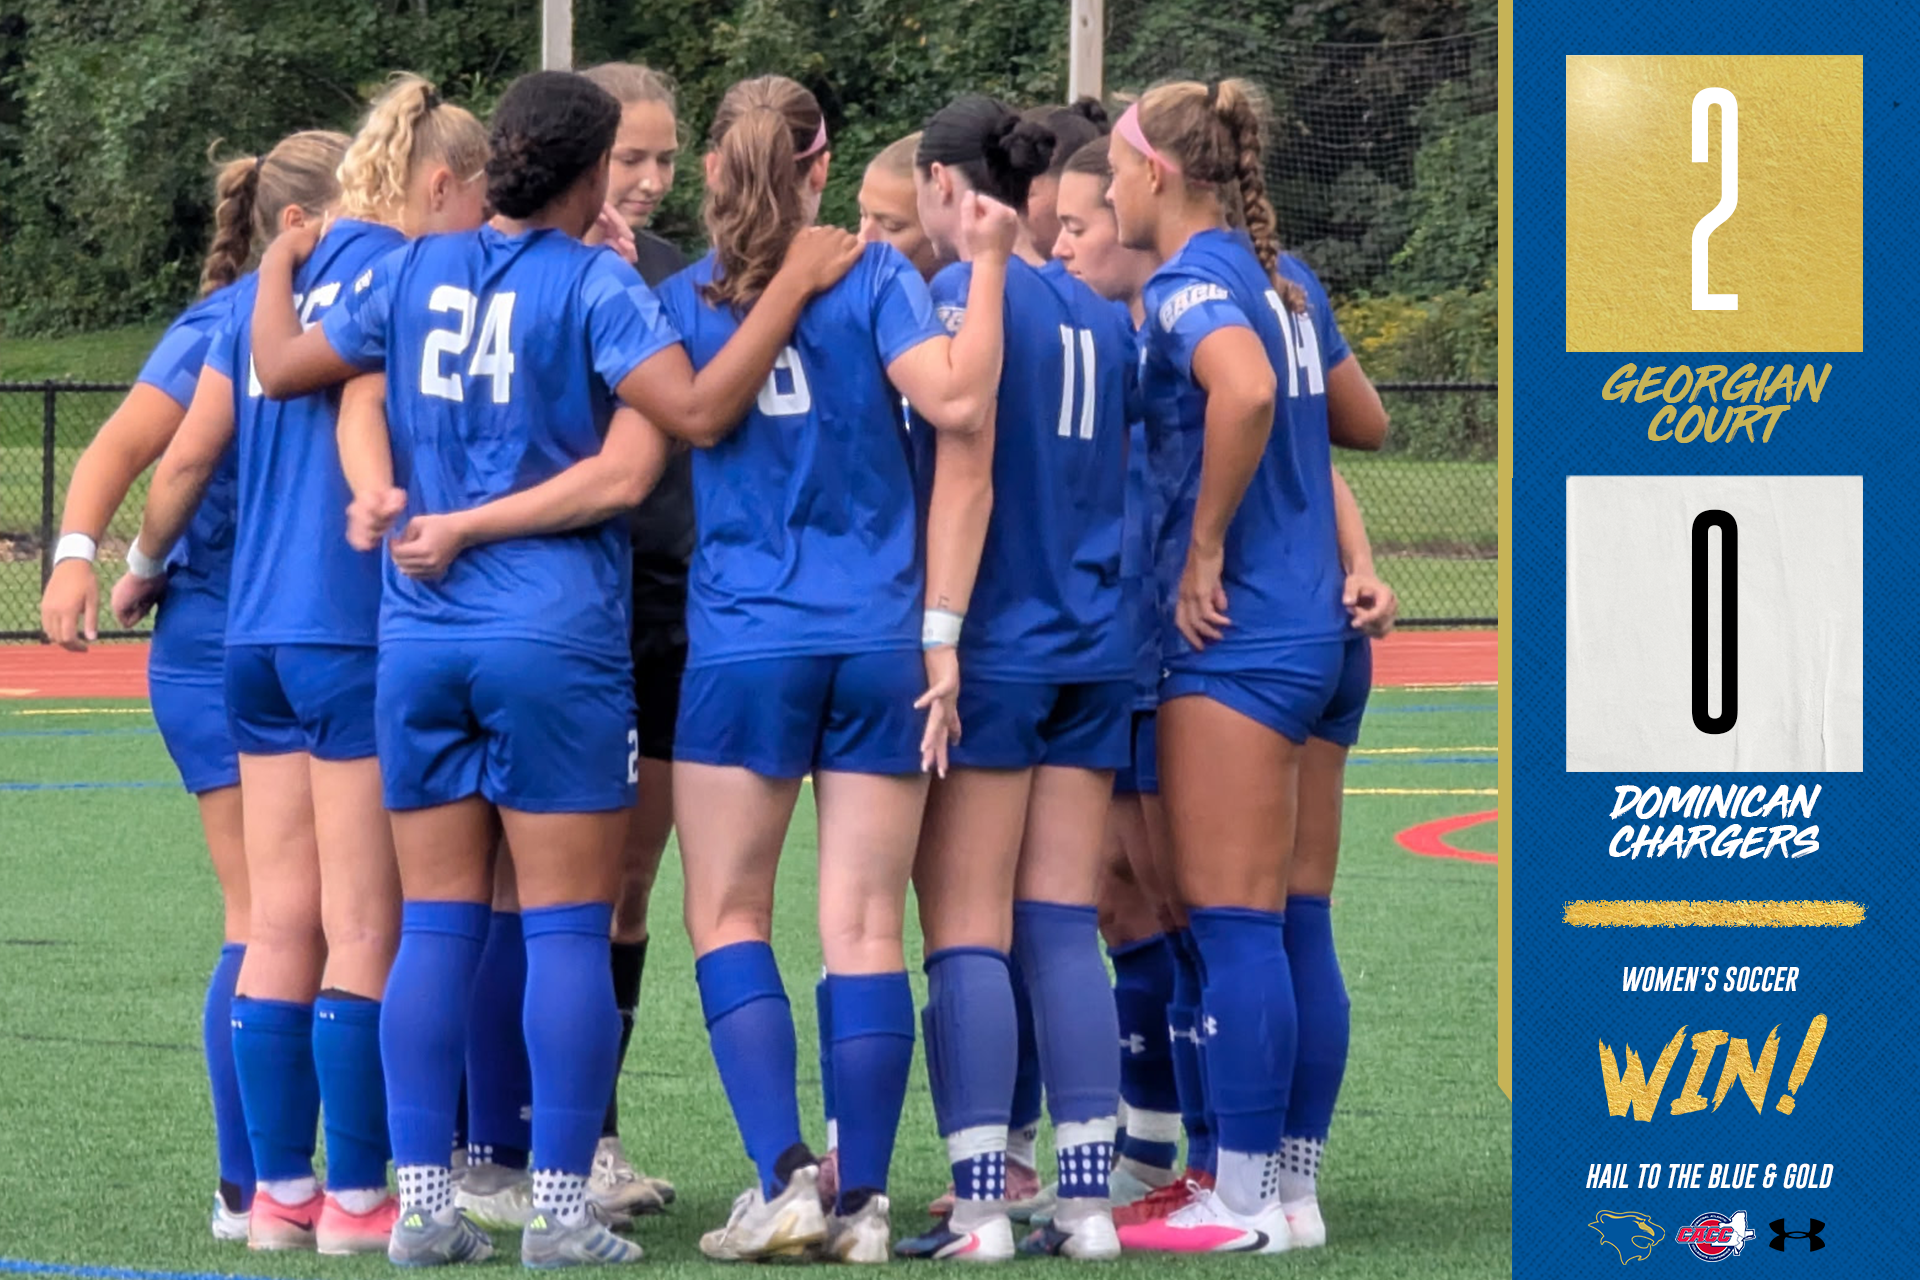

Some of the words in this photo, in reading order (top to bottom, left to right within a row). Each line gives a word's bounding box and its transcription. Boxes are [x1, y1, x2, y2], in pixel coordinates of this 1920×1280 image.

[421, 285, 516, 403] 24
[1058, 323, 1096, 440] 11
[1264, 290, 1324, 397] 14
